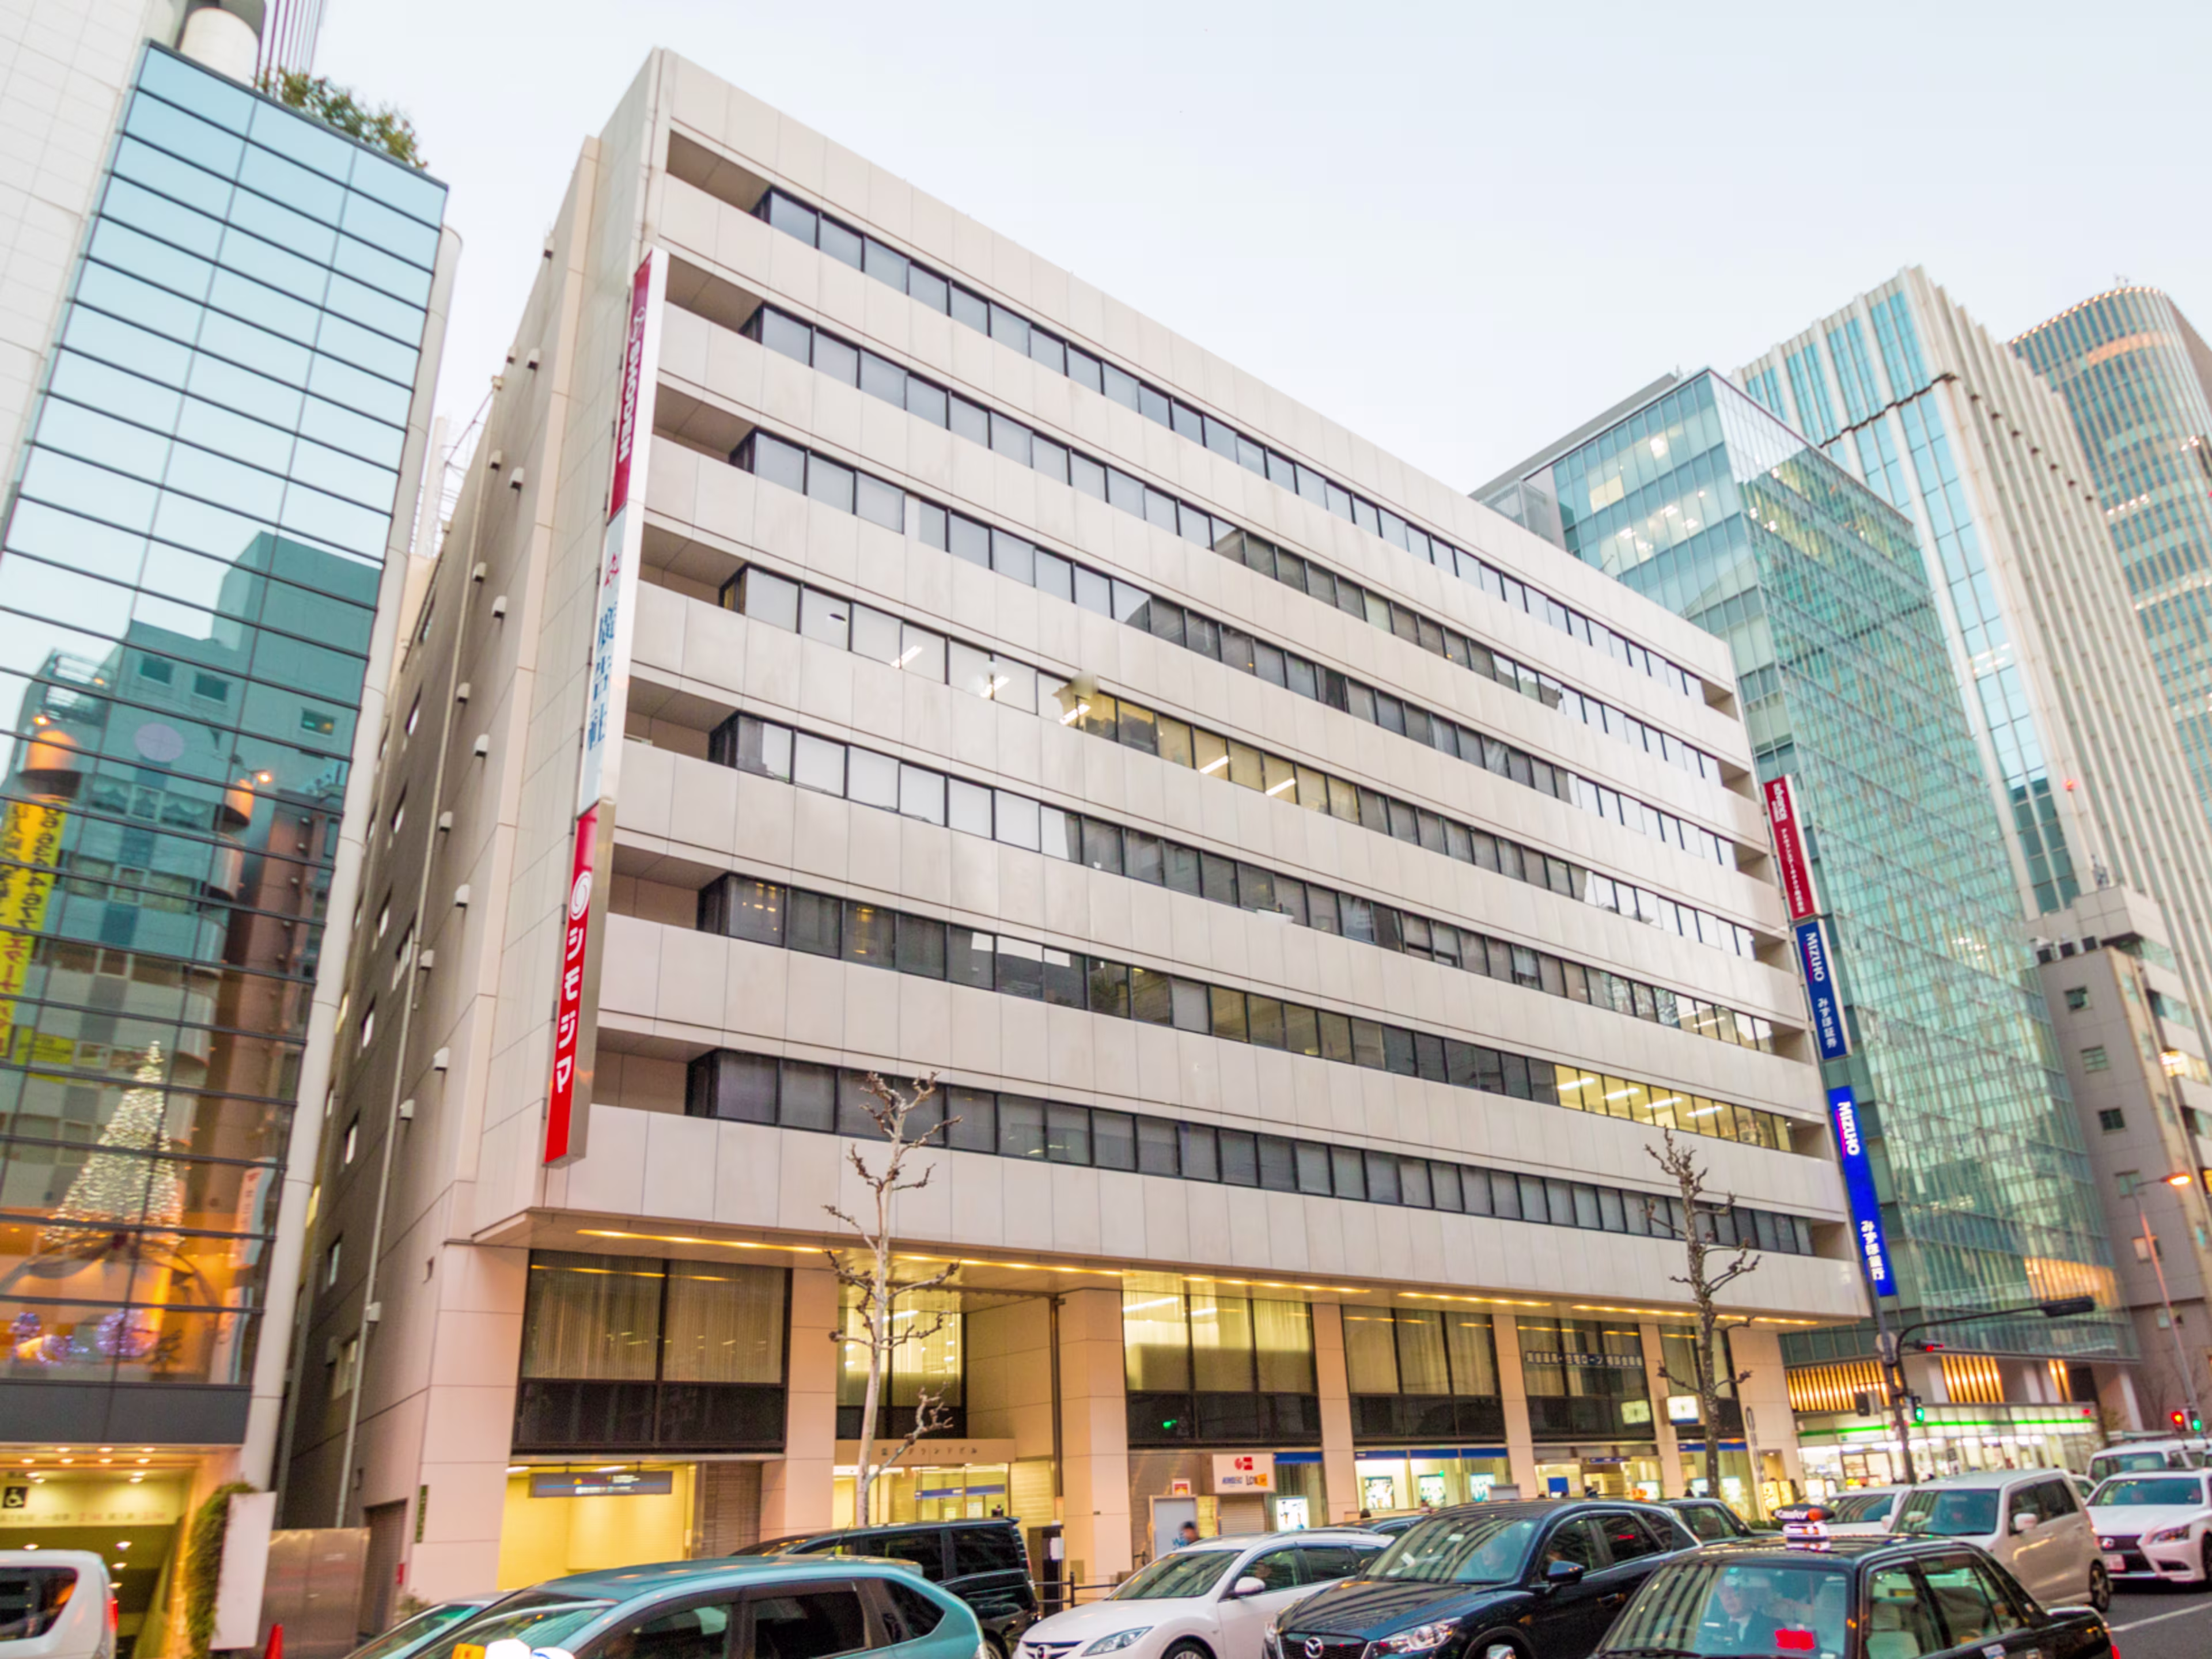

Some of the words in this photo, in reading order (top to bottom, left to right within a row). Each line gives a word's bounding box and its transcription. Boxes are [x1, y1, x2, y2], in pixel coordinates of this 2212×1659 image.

[1805, 931, 1825, 982] MIZUHO
[556, 926, 584, 1094] シモジマ
[1817, 997, 1837, 1049] みずほ証券
[1838, 1100, 1860, 1156] MIZUHO
[1861, 1219, 1885, 1281] みずほ銀行
